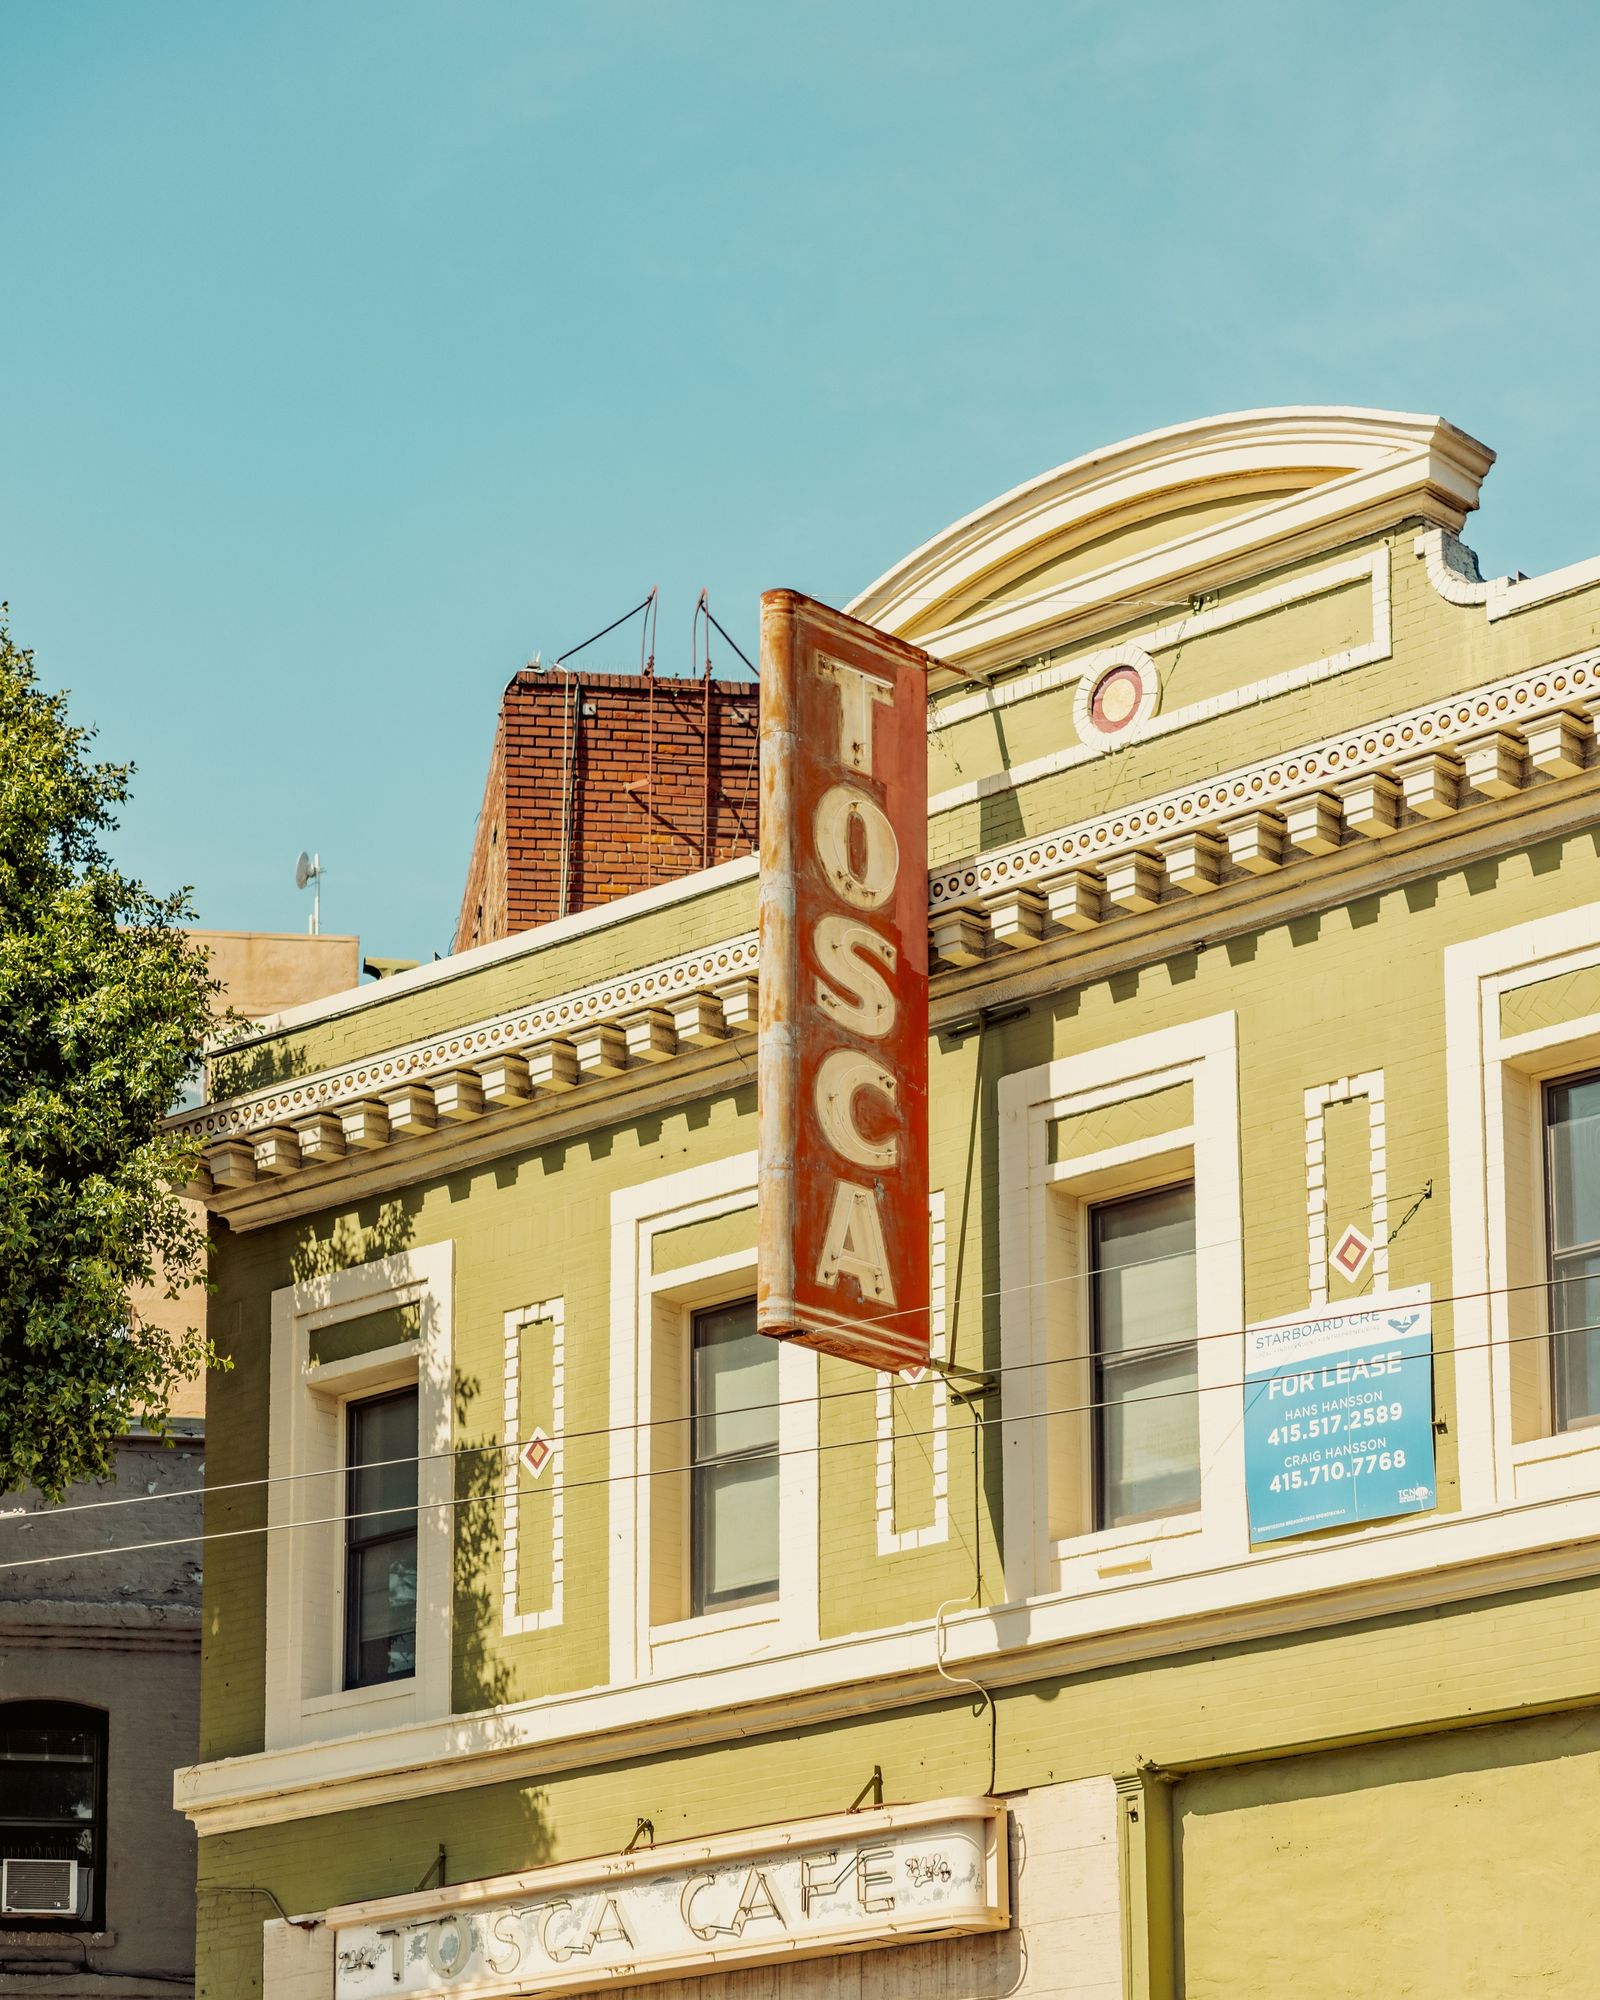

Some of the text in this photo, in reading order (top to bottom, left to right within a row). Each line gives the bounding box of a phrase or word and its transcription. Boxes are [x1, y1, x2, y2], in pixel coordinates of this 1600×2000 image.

[816, 647, 899, 1307] TOSCA
[1256, 1311, 1381, 1349] STARBOARD CRE
[1269, 1351, 1403, 1401] FOR LEASE
[1267, 1402, 1403, 1446] 415.517.2589
[1285, 1390, 1383, 1421] HANS HANSSON
[1269, 1449, 1407, 1493] 415.710.7768
[1284, 1437, 1387, 1468] CRAIG HANSSON
[376, 1840, 896, 1985] TOSCA CAFE
